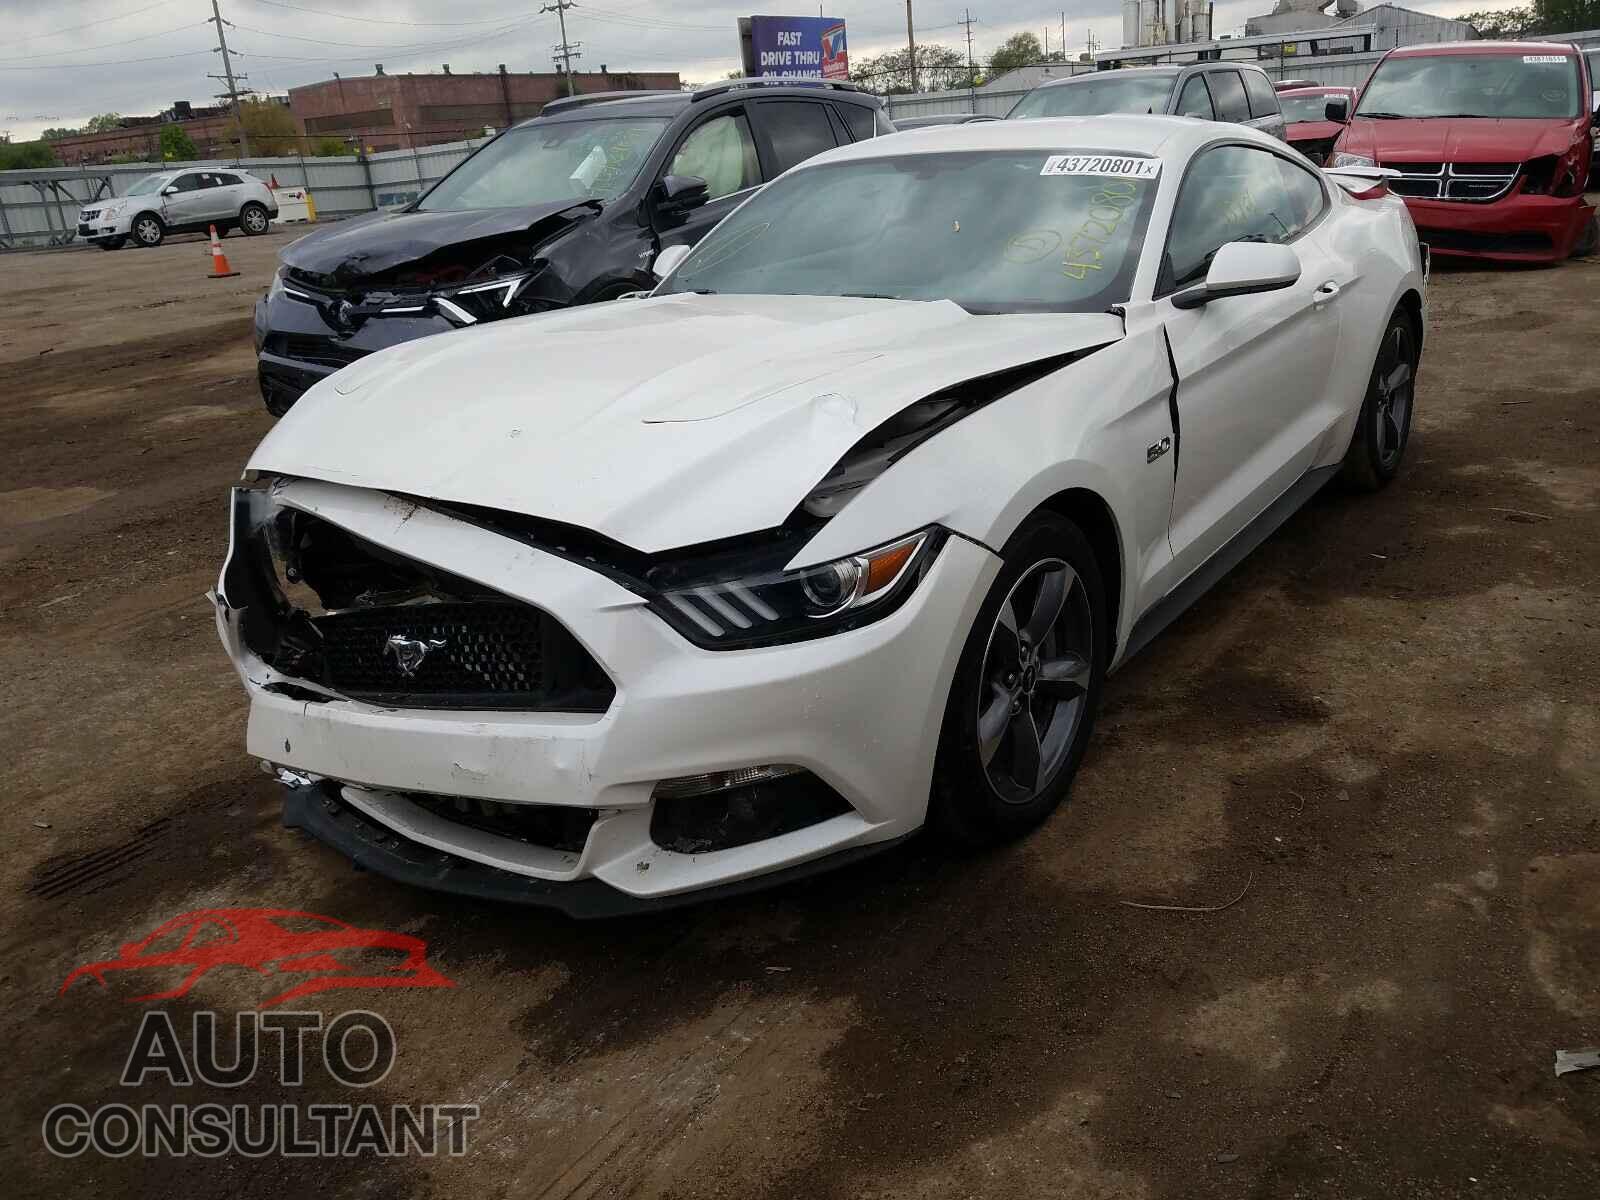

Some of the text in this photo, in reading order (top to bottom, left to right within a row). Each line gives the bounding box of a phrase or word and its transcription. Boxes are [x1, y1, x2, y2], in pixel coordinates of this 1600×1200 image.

[777, 31, 802, 46] FAST
[760, 51, 821, 66] DRIVE THRU
